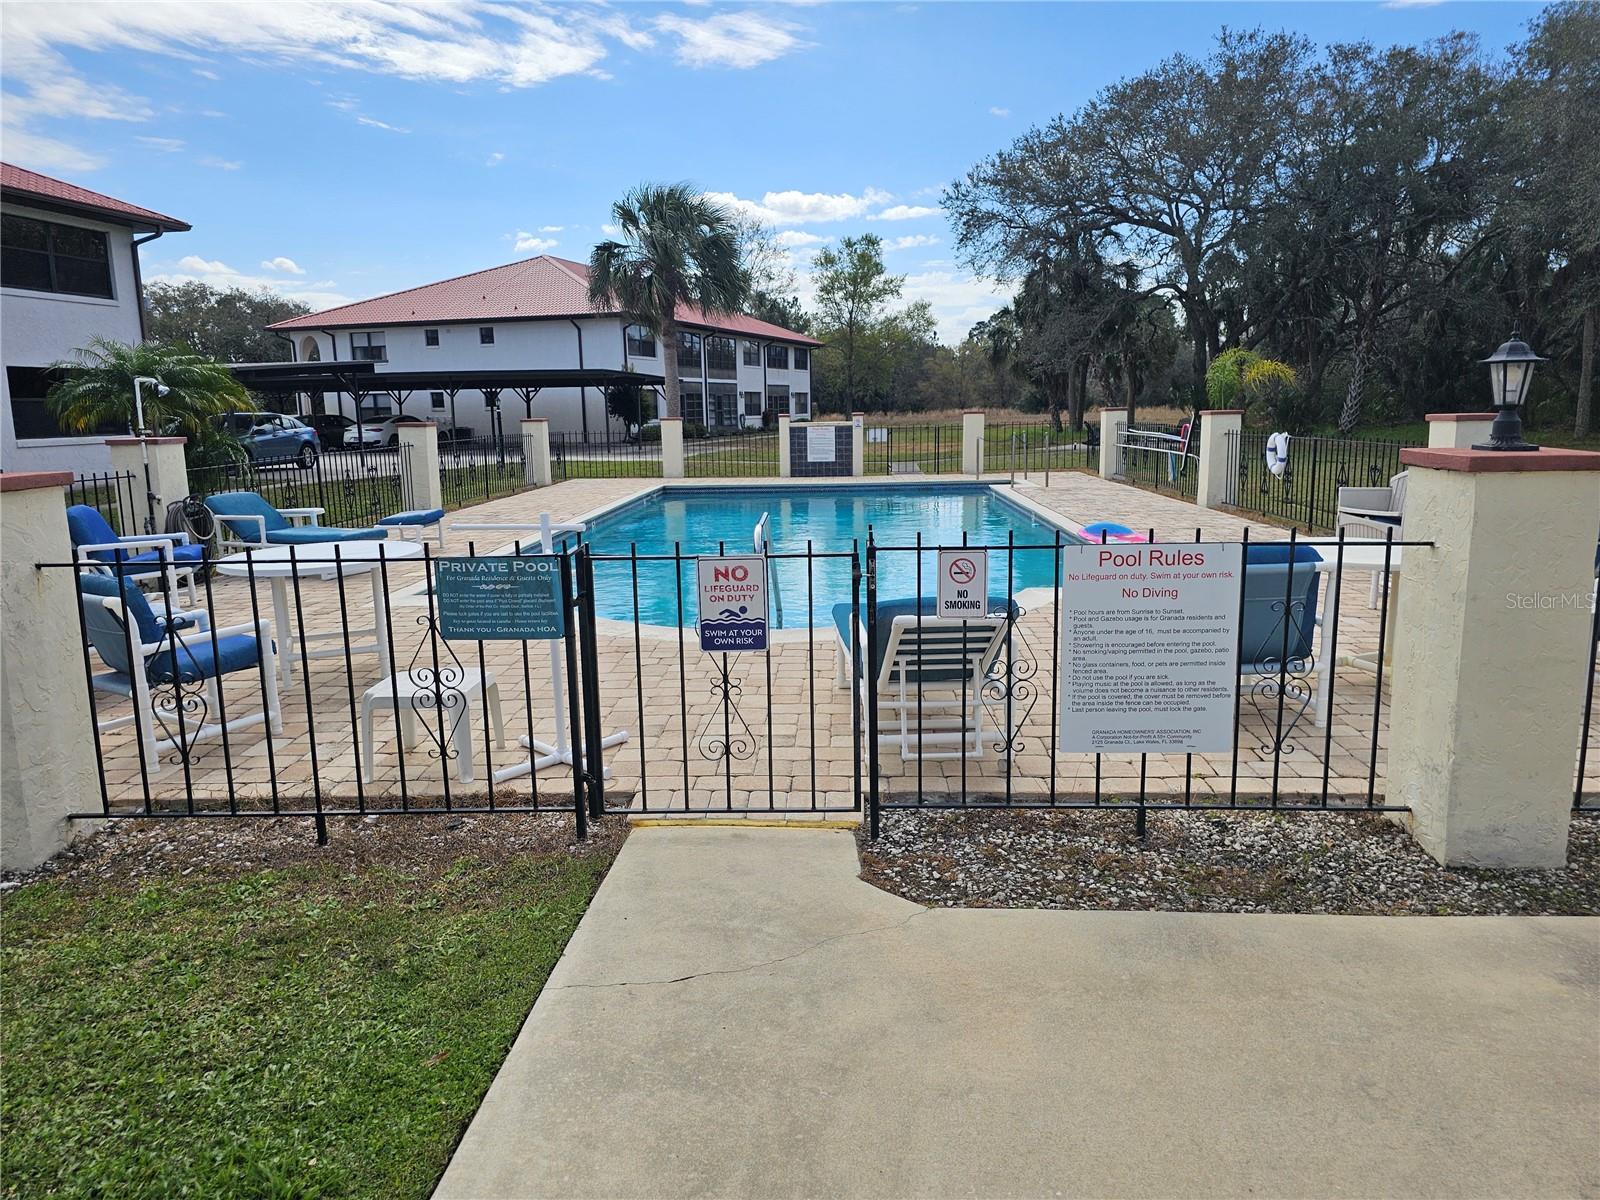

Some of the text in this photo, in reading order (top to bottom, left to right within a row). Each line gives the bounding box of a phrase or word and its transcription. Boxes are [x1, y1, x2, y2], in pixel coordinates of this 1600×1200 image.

[1099, 549, 1205, 567] Pool Rules
[714, 565, 749, 582] NO
[1068, 573, 1080, 581] No
[1081, 572, 1116, 582] Lifeguard
[1130, 572, 1148, 582] duty.
[1150, 572, 1170, 580] Swim
[1182, 573, 1199, 581] your
[704, 584, 759, 593] LIFEGUARD
[1122, 587, 1178, 600] No Diving
[957, 590, 968, 598] NO
[944, 600, 980, 610] SMOKING
